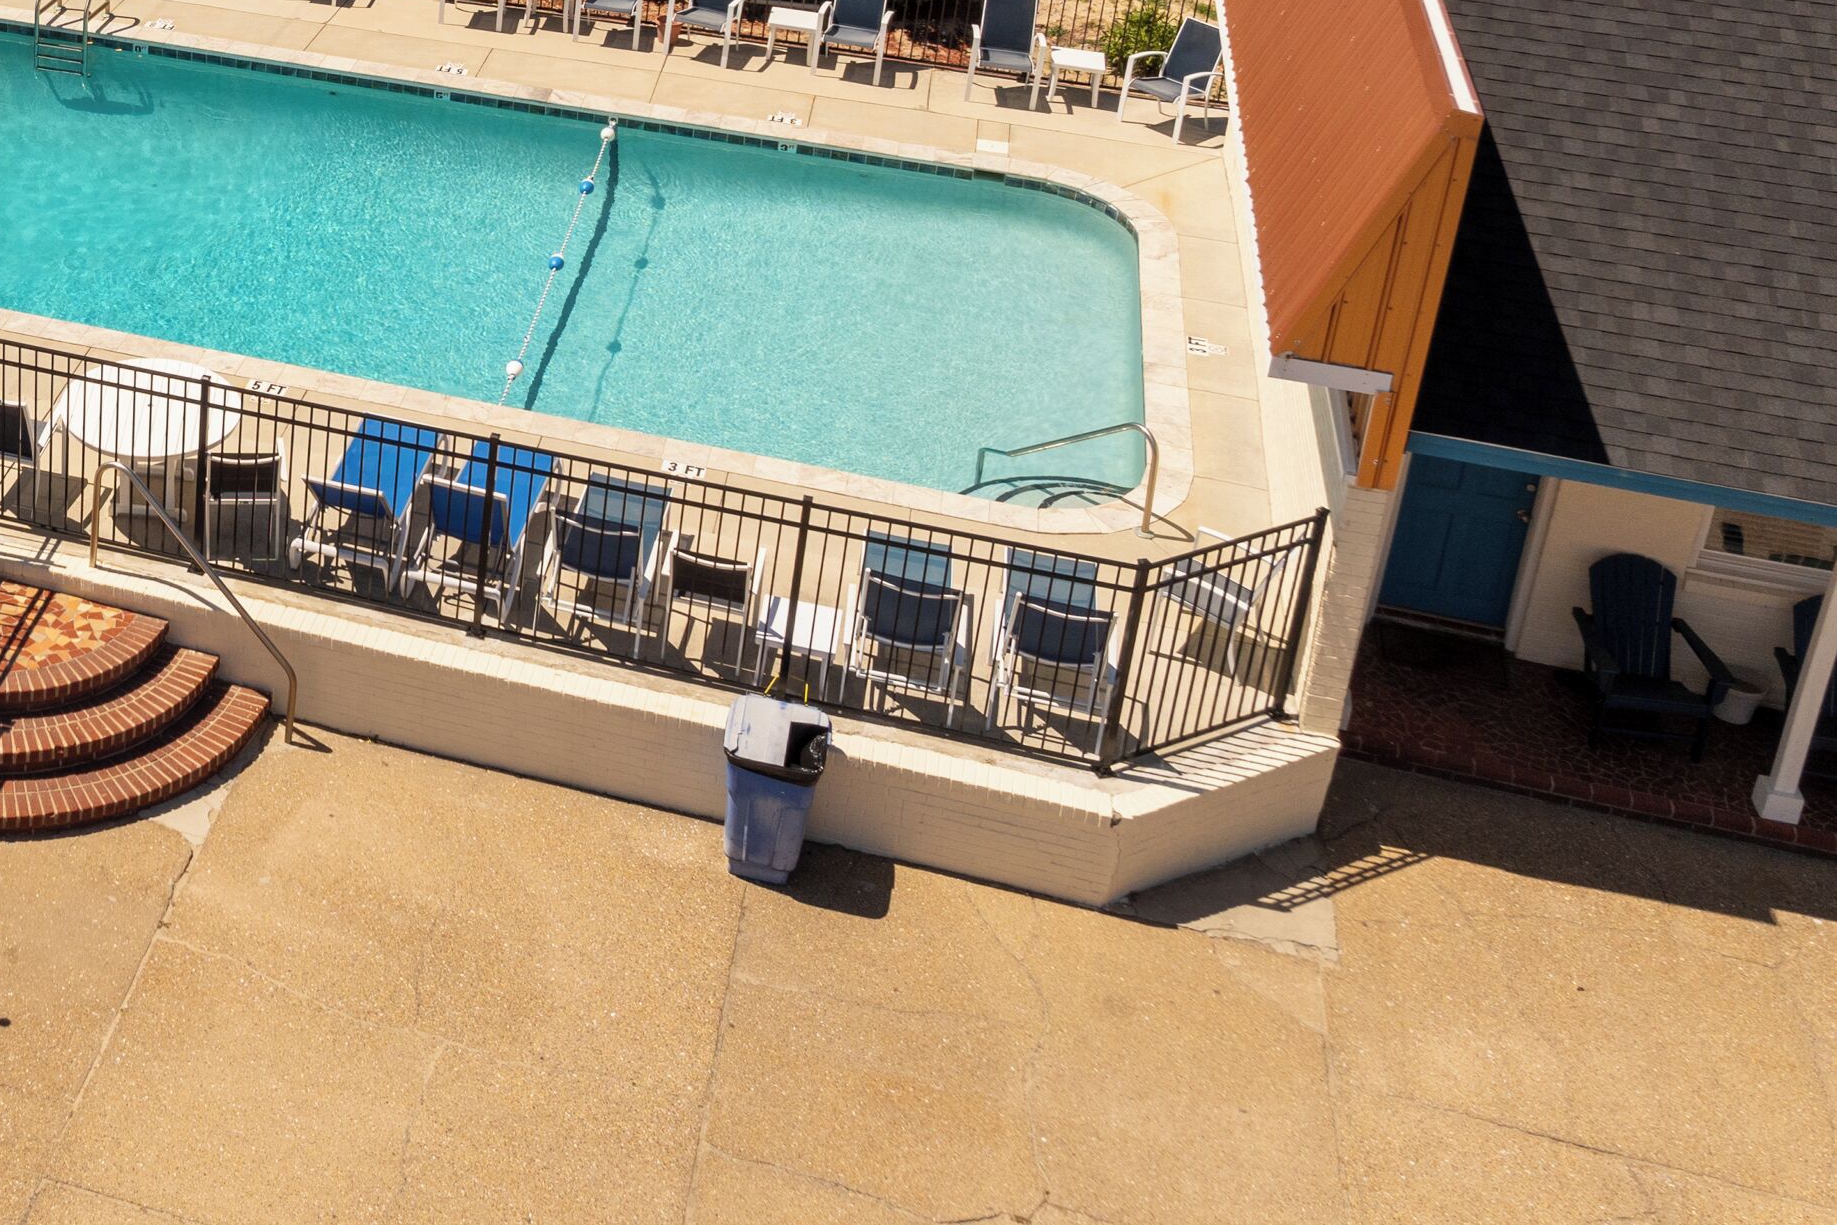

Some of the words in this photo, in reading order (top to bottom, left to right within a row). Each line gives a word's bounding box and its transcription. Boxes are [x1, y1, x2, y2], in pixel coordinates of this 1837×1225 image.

[251, 380, 262, 391] 5
[266, 383, 287, 395] FT
[668, 462, 679, 472] 3
[685, 465, 705, 477] FT
